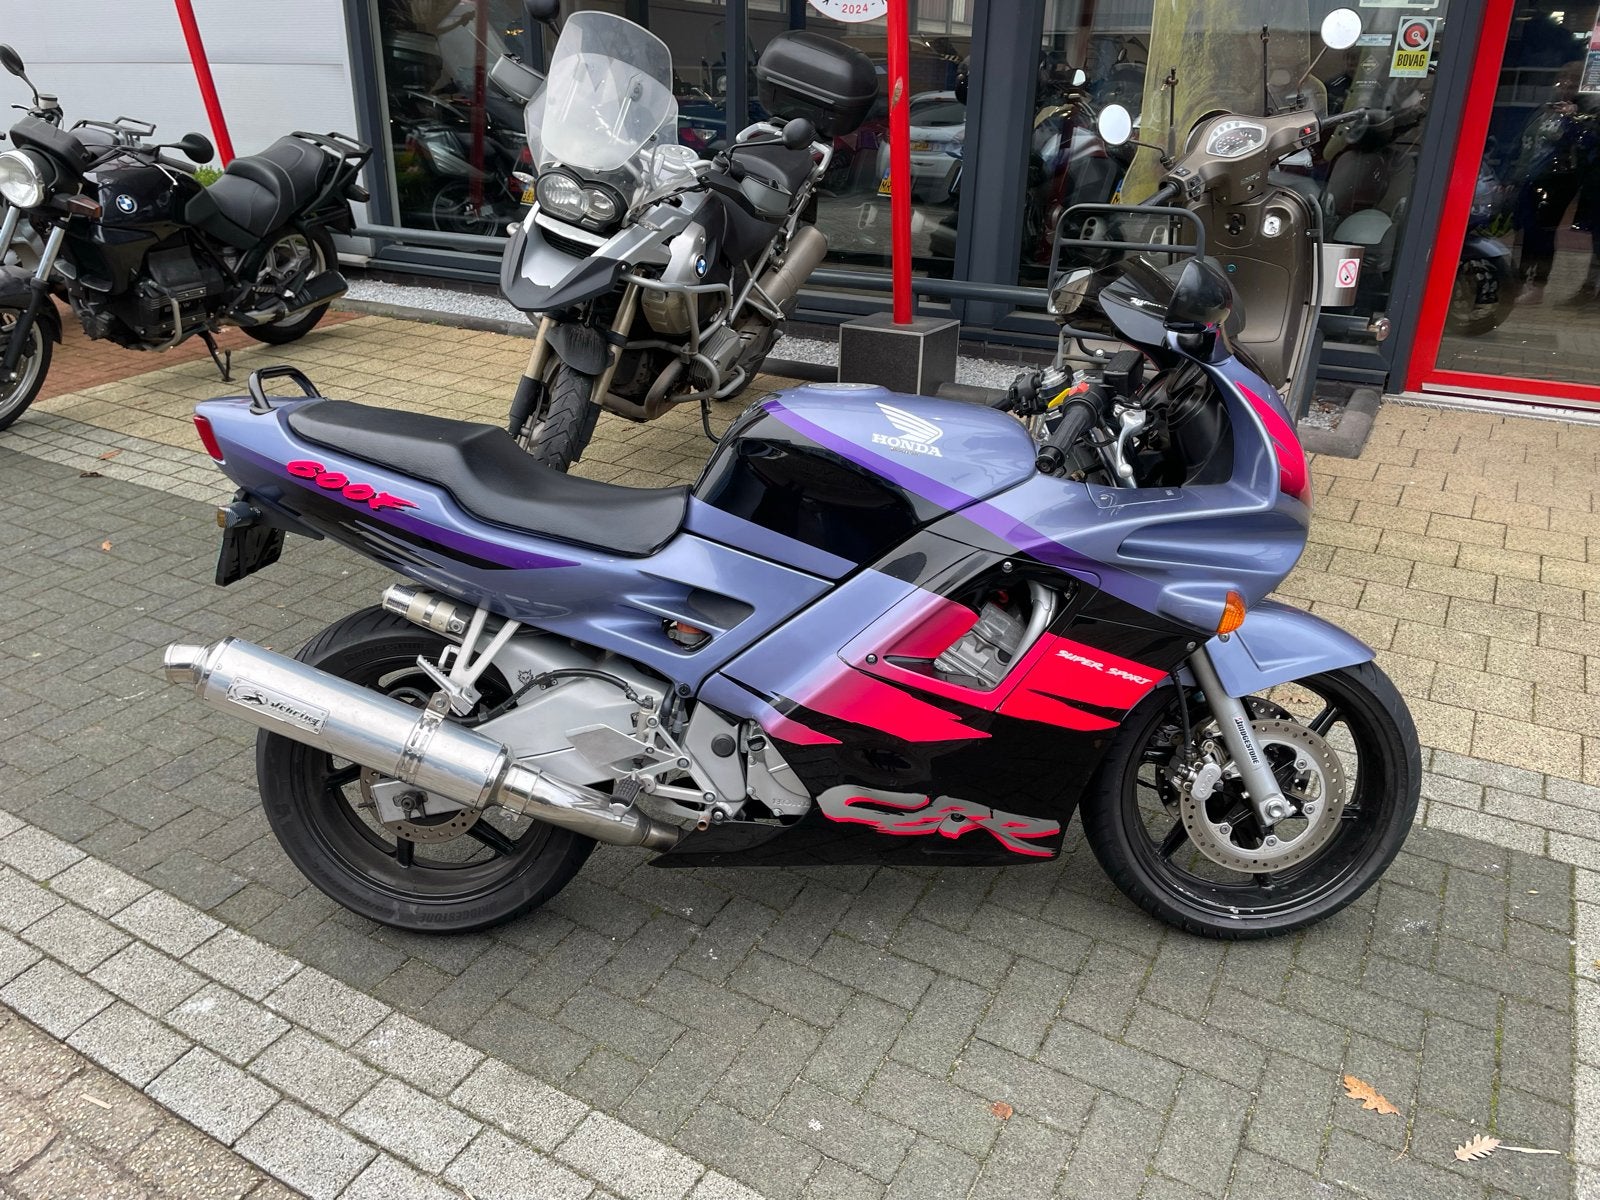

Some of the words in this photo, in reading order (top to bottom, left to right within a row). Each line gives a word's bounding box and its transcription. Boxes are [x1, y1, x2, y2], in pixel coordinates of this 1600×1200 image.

[841, 3, 869, 14] 2024
[1396, 53, 1426, 67] BOVAG
[871, 432, 943, 458] HONDA
[1055, 649, 1104, 672] SUPER
[1105, 667, 1153, 685] SPORT
[1234, 716, 1260, 764] BRIDGESTONE
